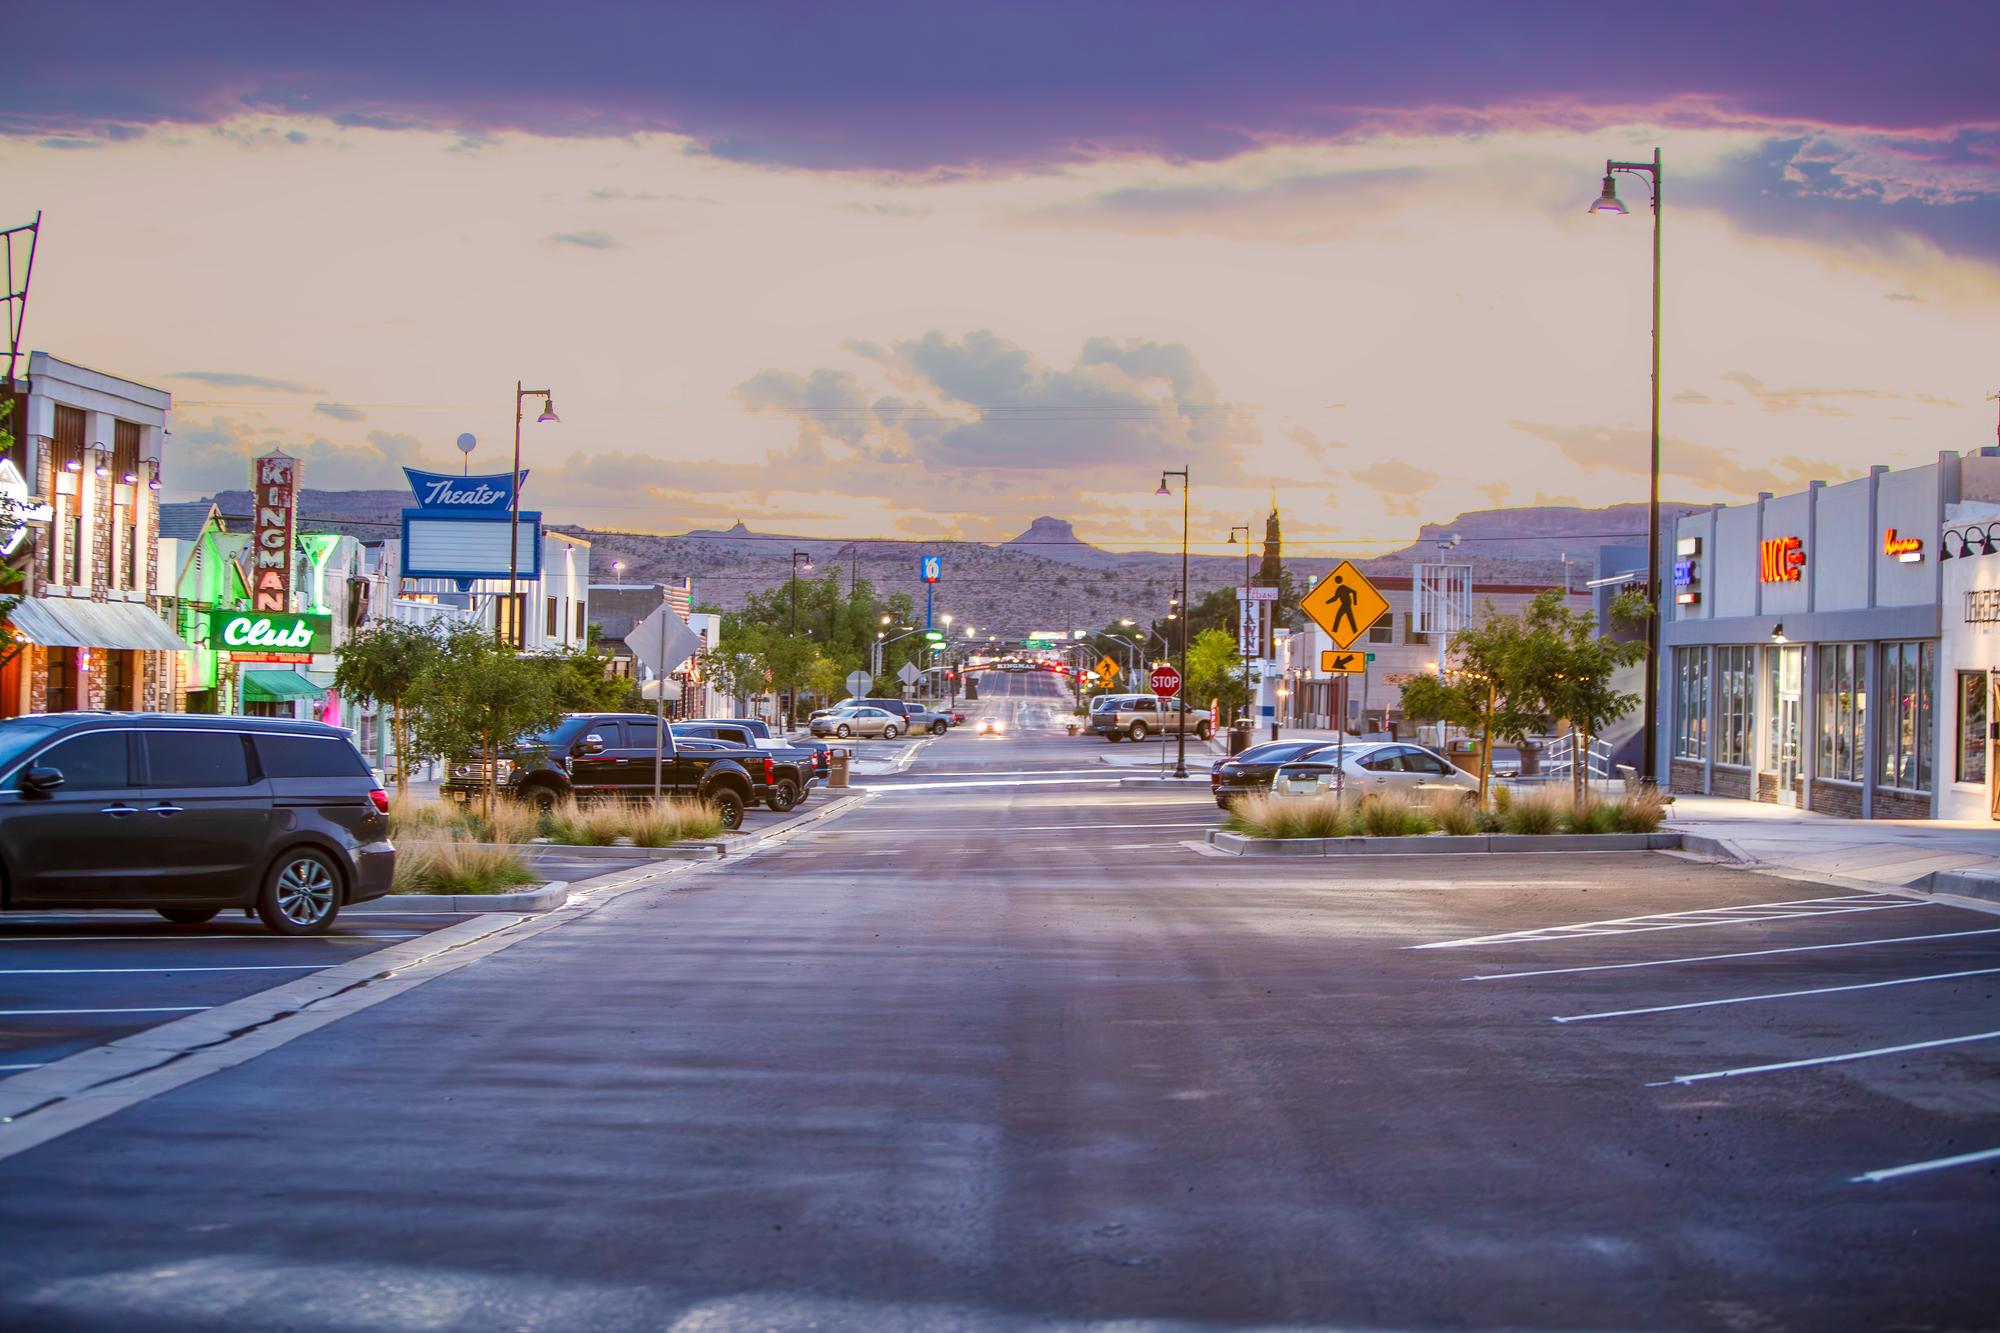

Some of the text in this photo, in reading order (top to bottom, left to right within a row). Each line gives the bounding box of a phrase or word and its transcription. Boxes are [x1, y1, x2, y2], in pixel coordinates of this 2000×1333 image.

[424, 480, 506, 505] Theater
[257, 466, 287, 611] KINGMAN
[224, 617, 315, 648] Club
[1242, 601, 1257, 649] PAWN
[1151, 675, 1179, 689] STOP
